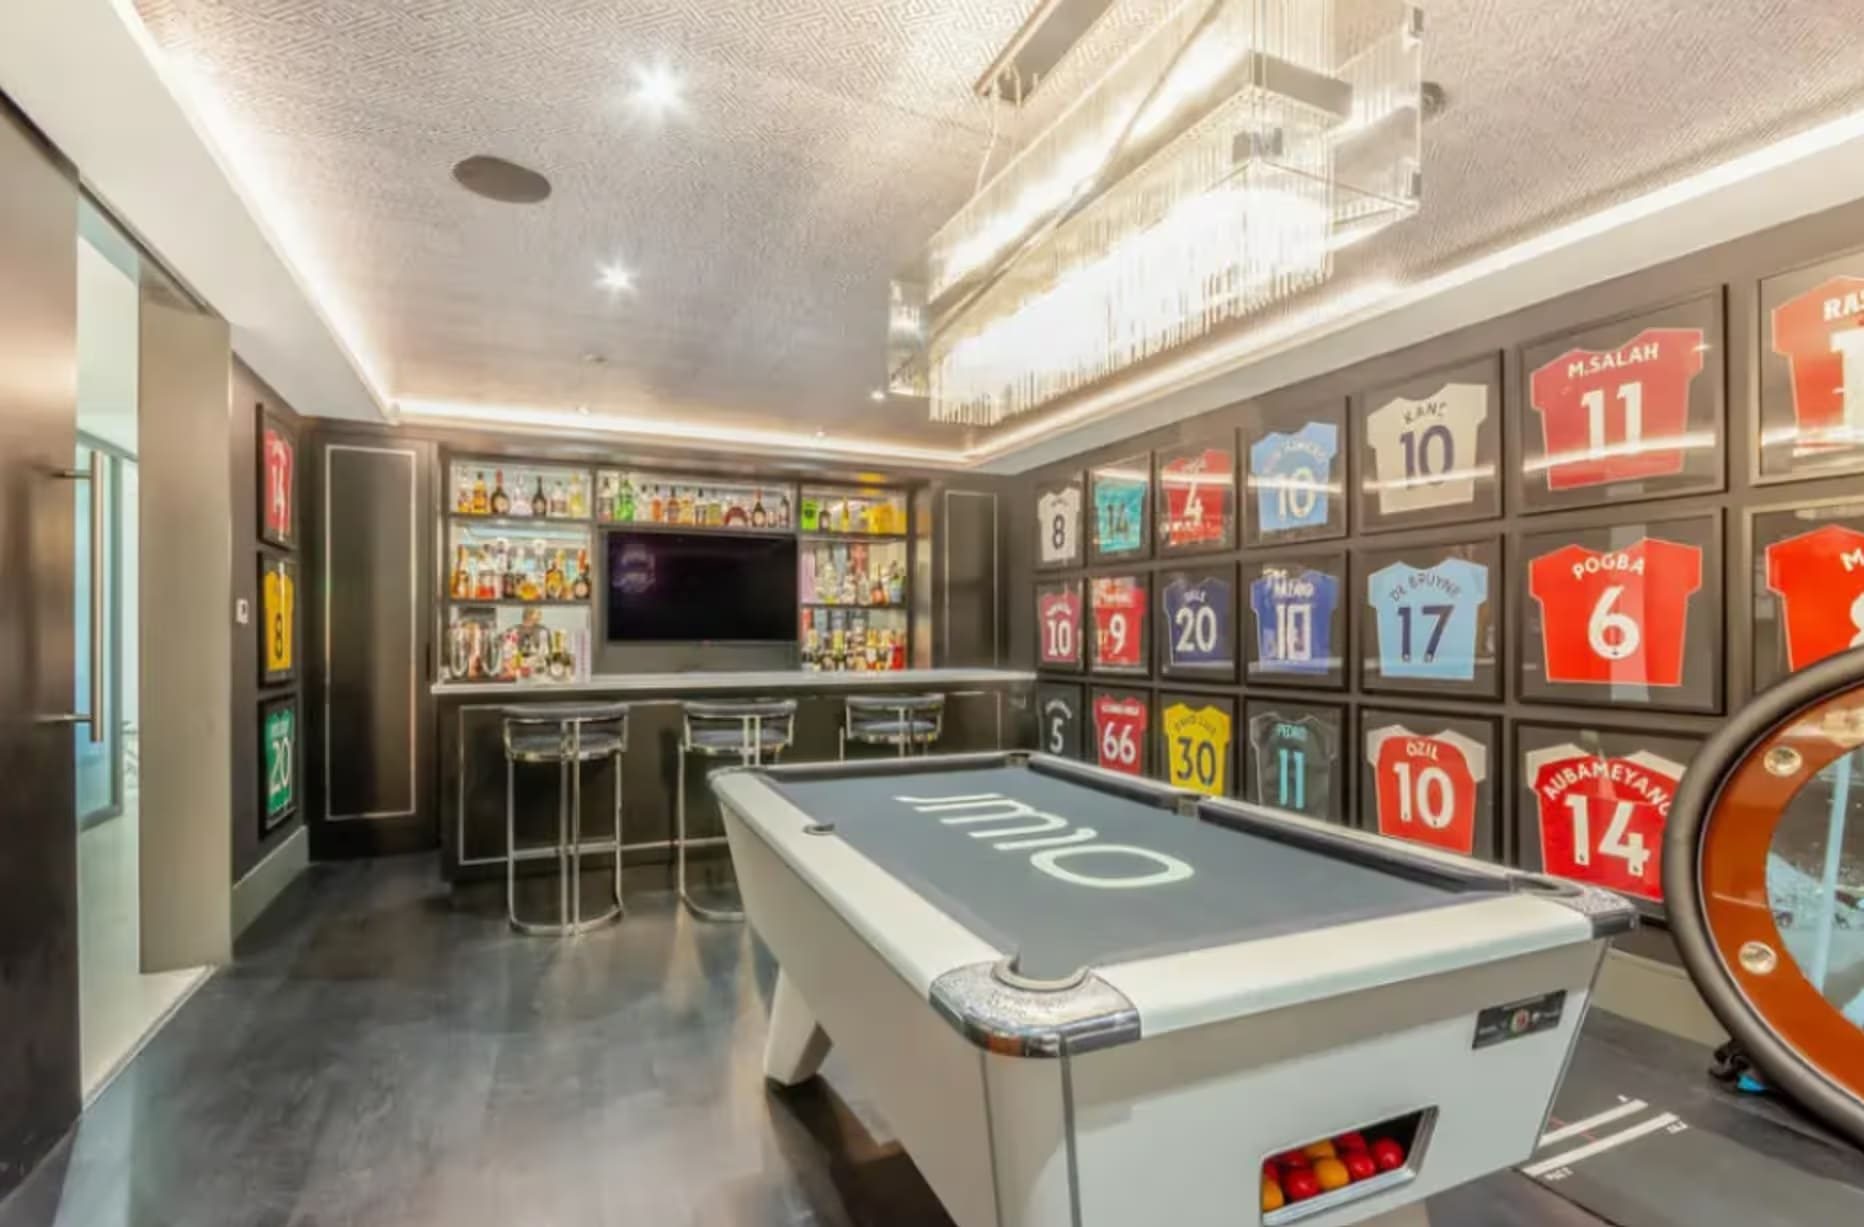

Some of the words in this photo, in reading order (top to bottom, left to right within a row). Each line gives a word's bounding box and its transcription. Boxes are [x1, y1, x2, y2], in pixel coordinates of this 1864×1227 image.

[1568, 342, 1659, 379] M.SALAH
[1580, 381, 1642, 459] 11
[1399, 424, 1454, 488] 10
[1278, 467, 1315, 522] 10
[1053, 513, 1065, 550] 8
[1572, 554, 1645, 581] POGBA
[1047, 619, 1072, 656] 10
[1109, 613, 1126, 656] 9
[1175, 606, 1217, 653] 20
[1277, 603, 1312, 661] 10
[1398, 605, 1454, 662] 17
[1588, 585, 1640, 660] 6
[1050, 717, 1064, 753] 5
[1103, 721, 1136, 764] 66
[1177, 736, 1216, 787] 30
[1279, 749, 1304, 809] 11
[1393, 762, 1454, 829] 10
[1564, 794, 1651, 877] 14
